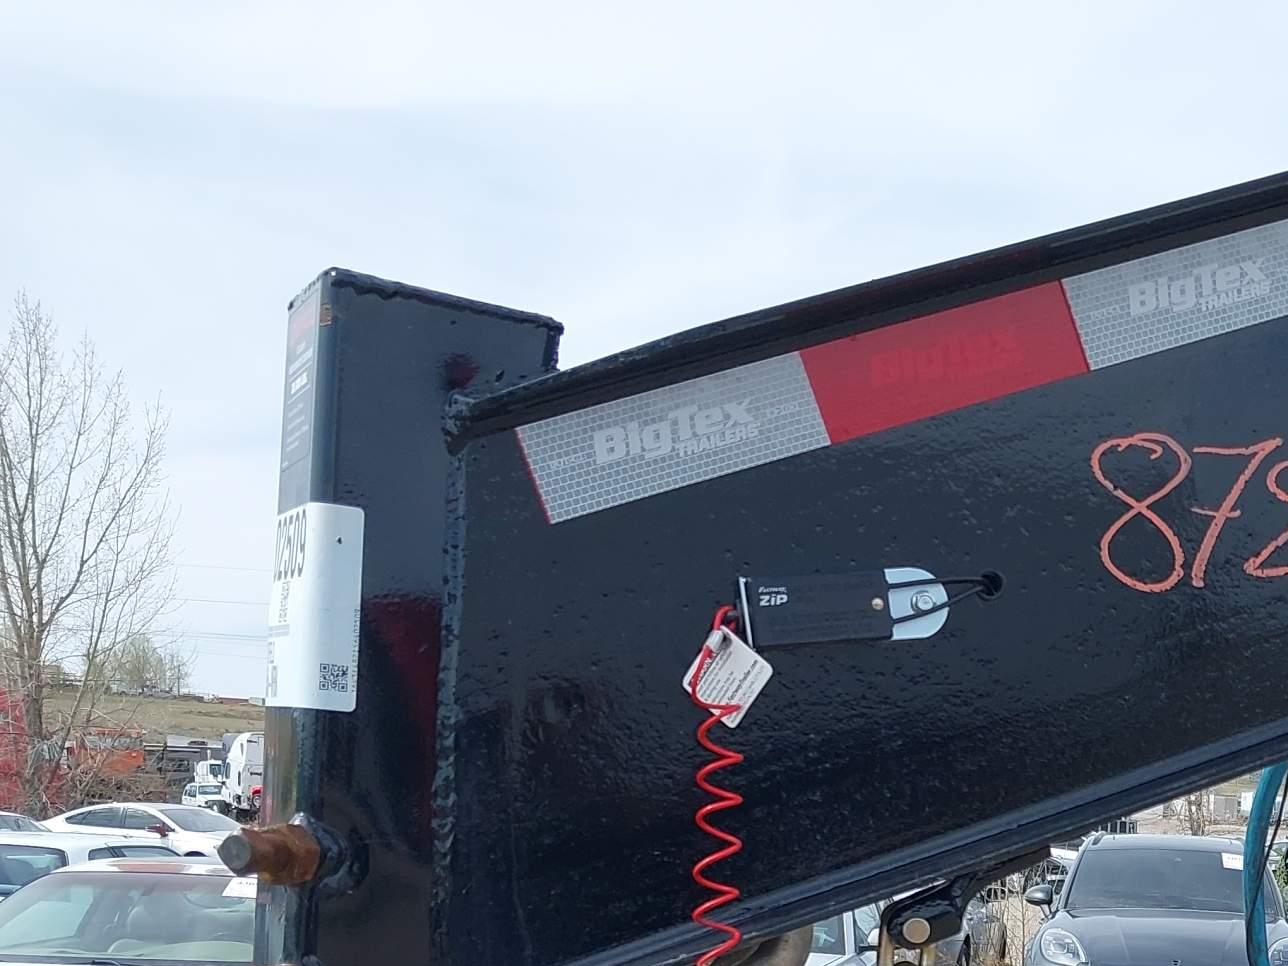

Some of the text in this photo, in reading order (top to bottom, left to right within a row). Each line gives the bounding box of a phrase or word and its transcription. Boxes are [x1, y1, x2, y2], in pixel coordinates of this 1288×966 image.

[1128, 257, 1268, 316] BigTex
[1199, 279, 1273, 312] TRAILERS
[593, 397, 756, 465] BigTex
[676, 421, 761, 459] TRAILERS
